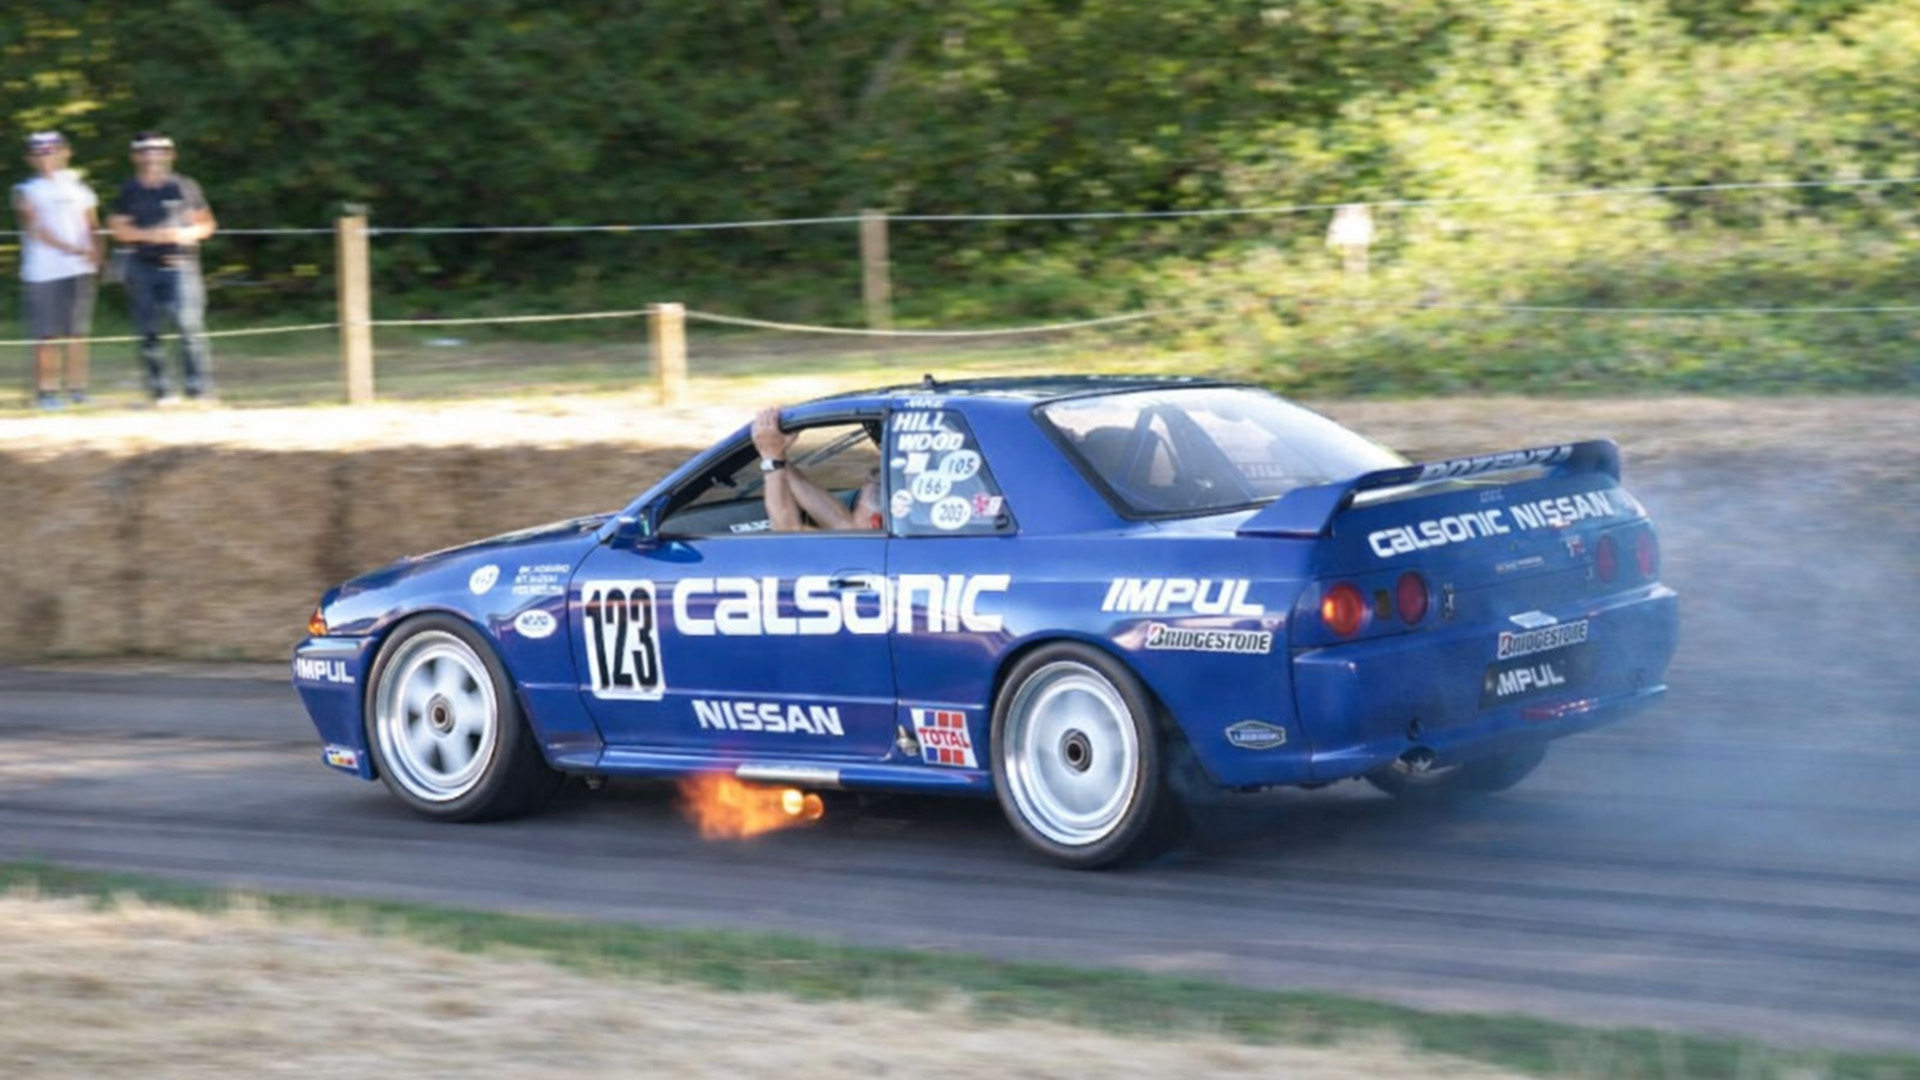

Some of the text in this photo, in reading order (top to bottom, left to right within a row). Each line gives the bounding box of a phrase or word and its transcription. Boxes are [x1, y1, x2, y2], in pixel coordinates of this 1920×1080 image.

[892, 411, 947, 432] HILL
[898, 432, 964, 451] WOOD
[1367, 509, 1511, 559] CALSONIC
[1510, 490, 1615, 533] NISSAN
[672, 574, 1011, 636] CALSONIC
[1101, 577, 1264, 616] IMPUL
[584, 588, 659, 692] 123
[1149, 624, 1270, 652] BRIDGESTONE
[1499, 621, 1588, 659] BRIDGESTONE
[296, 657, 355, 684] IMPUL
[691, 699, 845, 736] NISSAN
[918, 726, 971, 750] TOTAL
